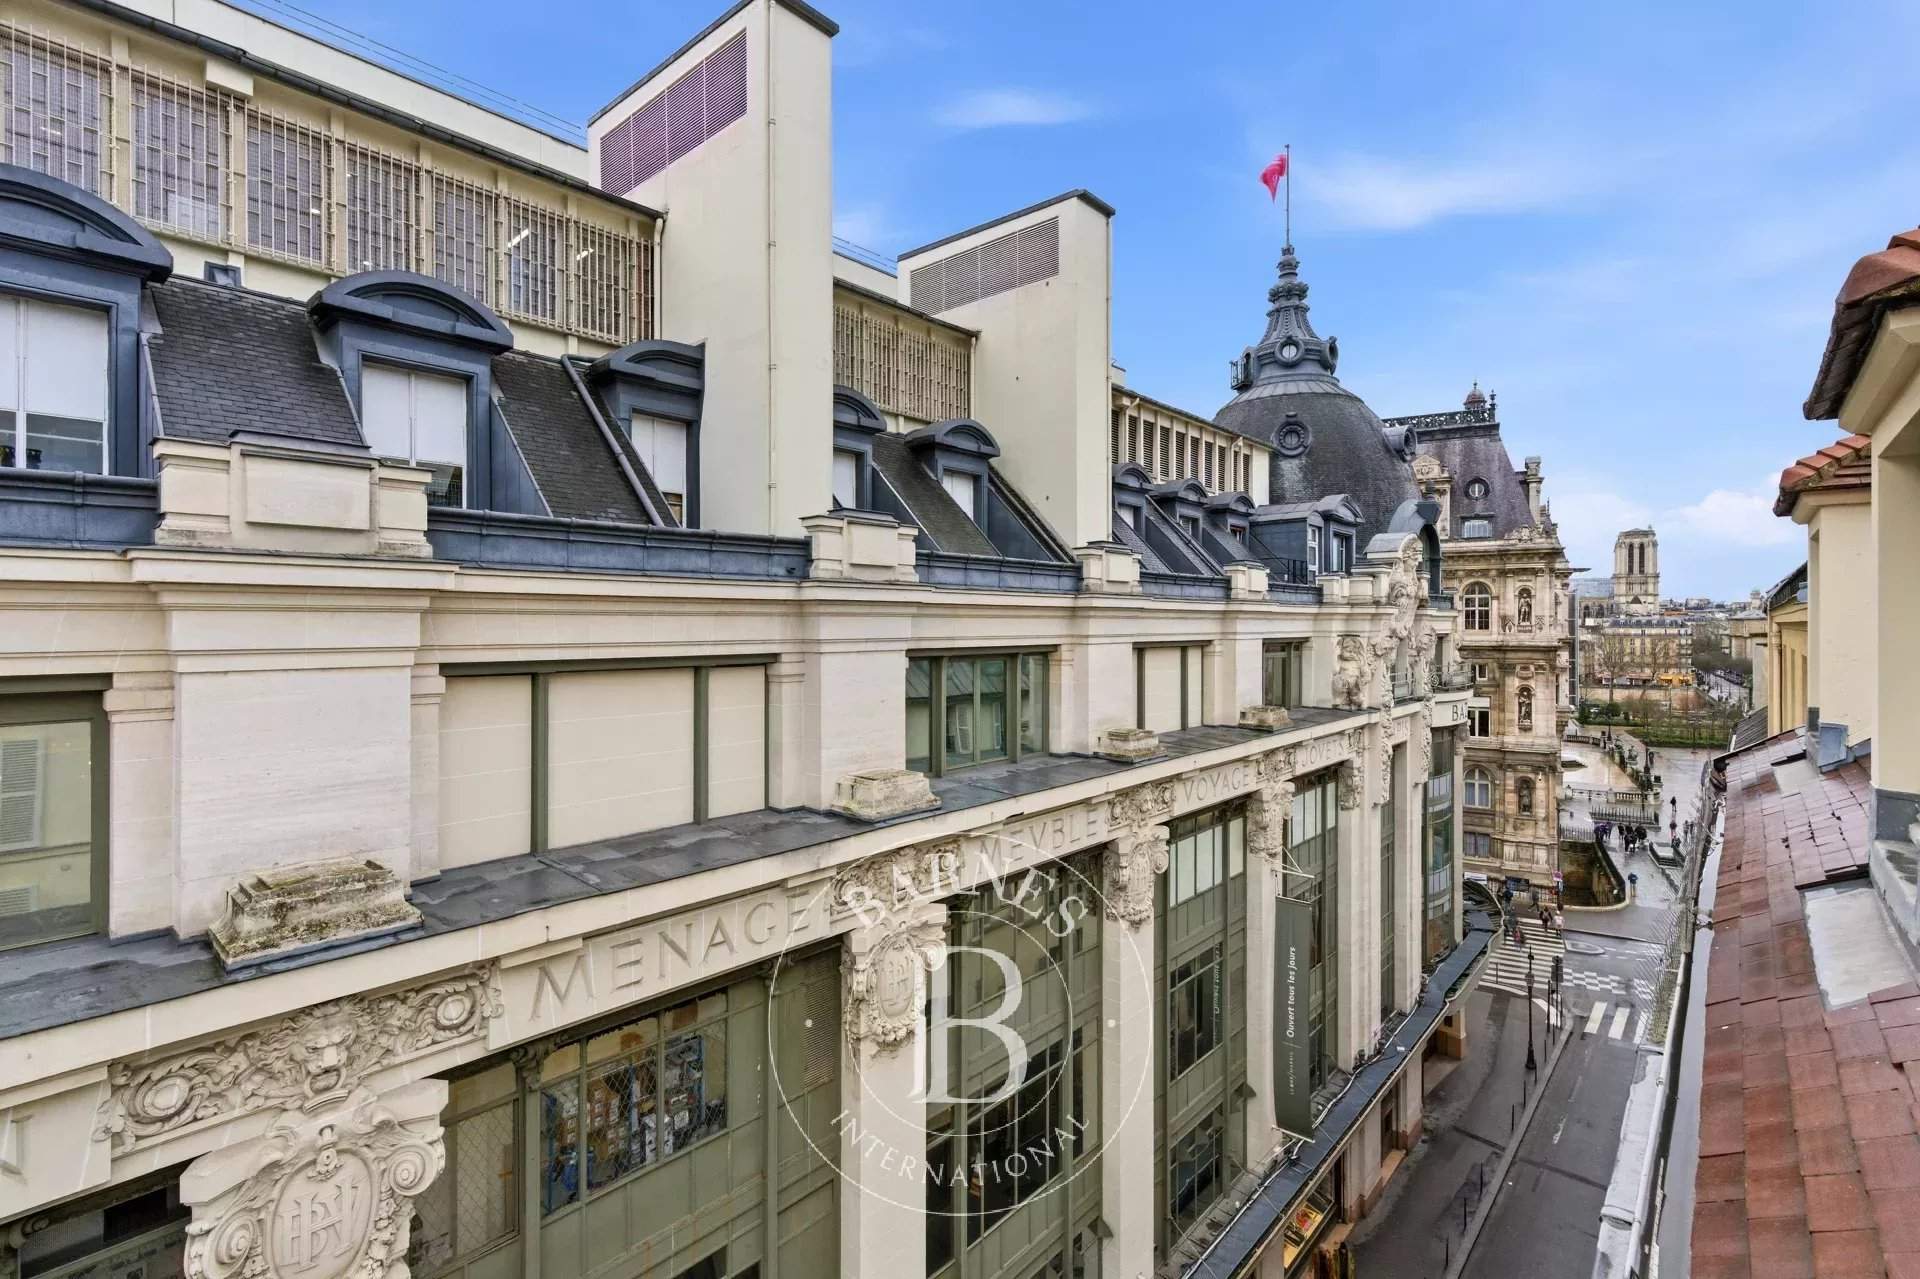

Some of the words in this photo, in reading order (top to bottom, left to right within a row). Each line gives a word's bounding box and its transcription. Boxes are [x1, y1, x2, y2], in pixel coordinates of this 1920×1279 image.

[1182, 764, 1250, 804] VOYAGE
[528, 889, 811, 1022] MENAGE
[1287, 946, 1298, 971] jours
[1287, 970, 1296, 984] les
[1287, 985, 1296, 1005] tous
[1286, 1006, 1296, 1038] Ouvert
